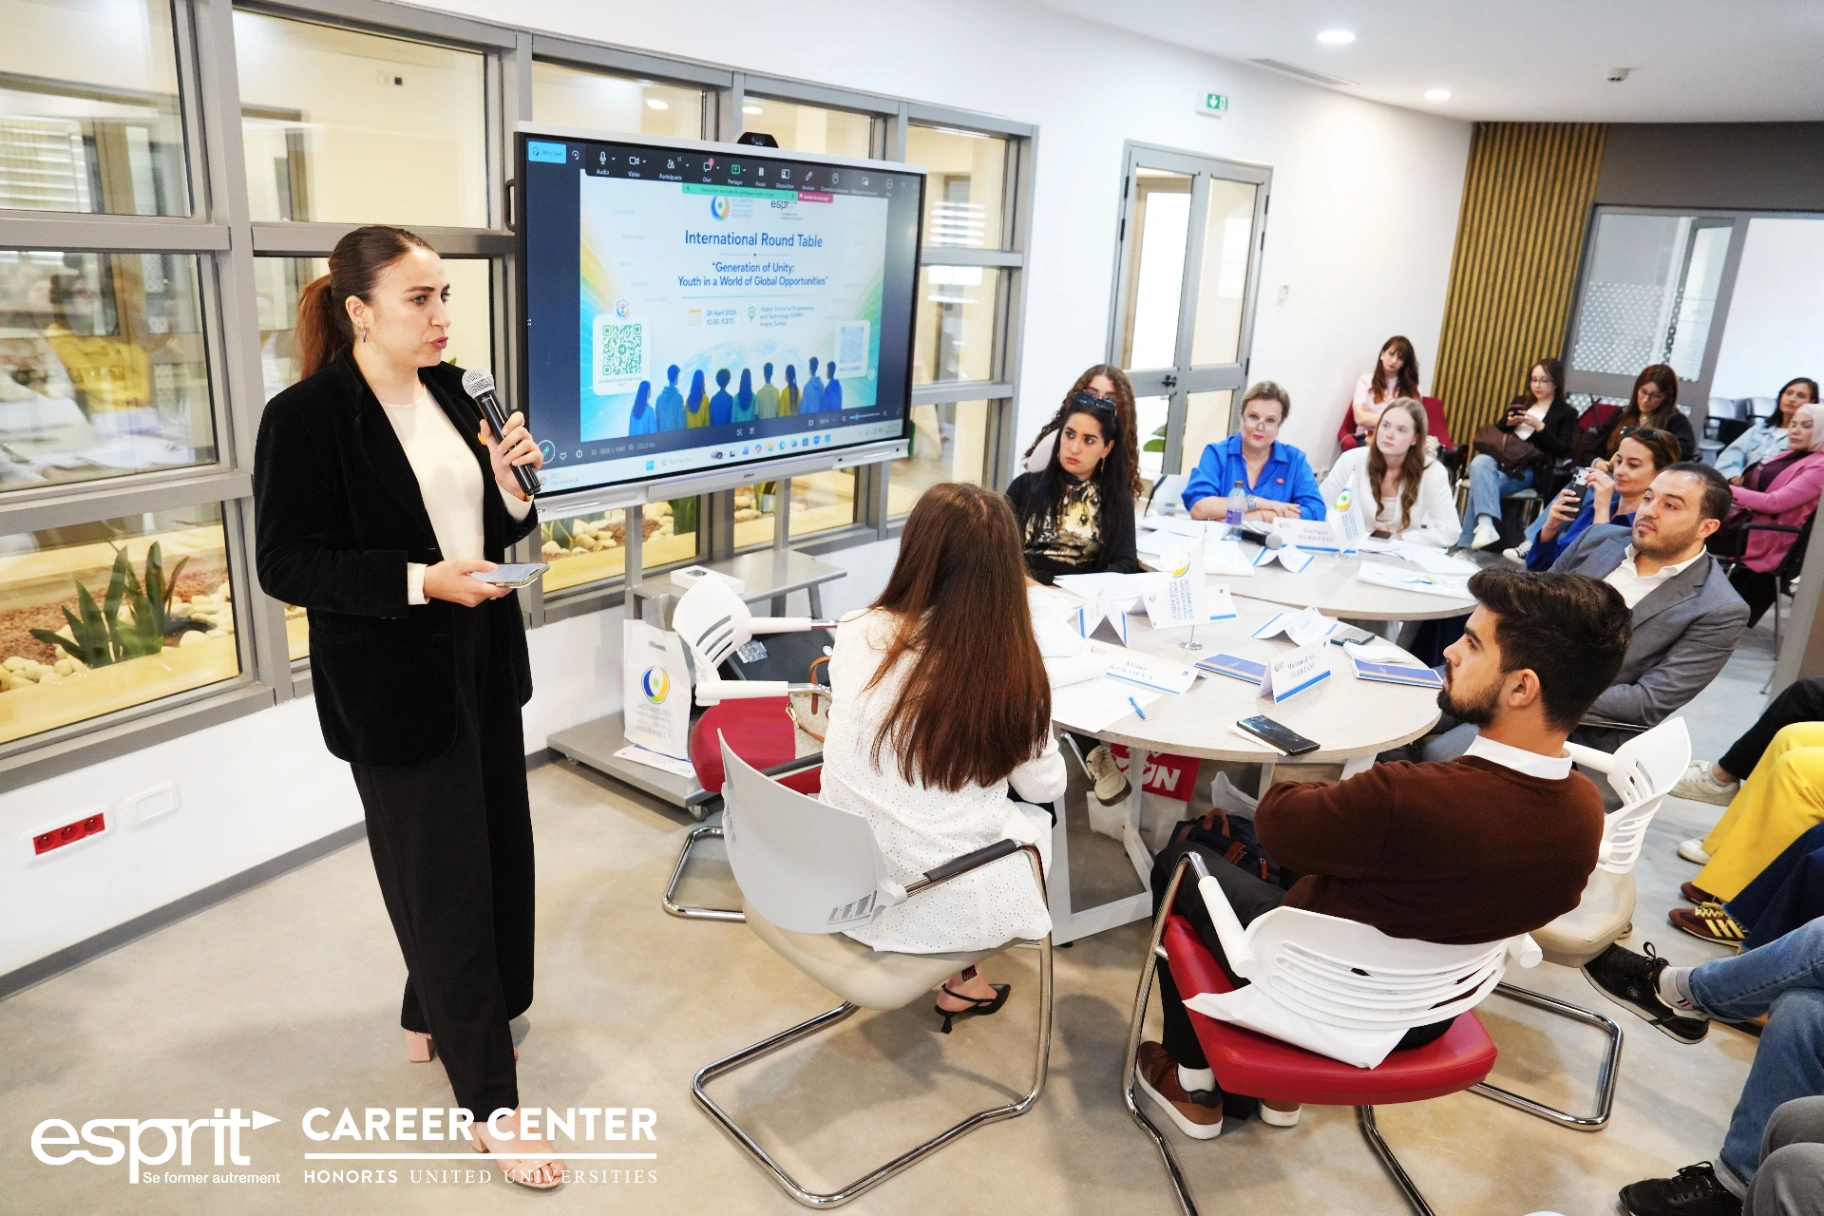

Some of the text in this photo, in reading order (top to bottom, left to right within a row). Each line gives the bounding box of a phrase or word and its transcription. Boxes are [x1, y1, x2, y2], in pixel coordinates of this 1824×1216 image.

[596, 168, 610, 176] Audio
[685, 230, 823, 248] International Round Table
[762, 262, 771, 273] of
[772, 262, 795, 275] Unity:
[678, 276, 701, 287] Youth
[703, 276, 710, 286] in
[712, 278, 718, 286] a
[720, 276, 743, 286] World
[745, 276, 752, 286] of
[754, 276, 777, 286] Global
[714, 309, 724, 317] April
